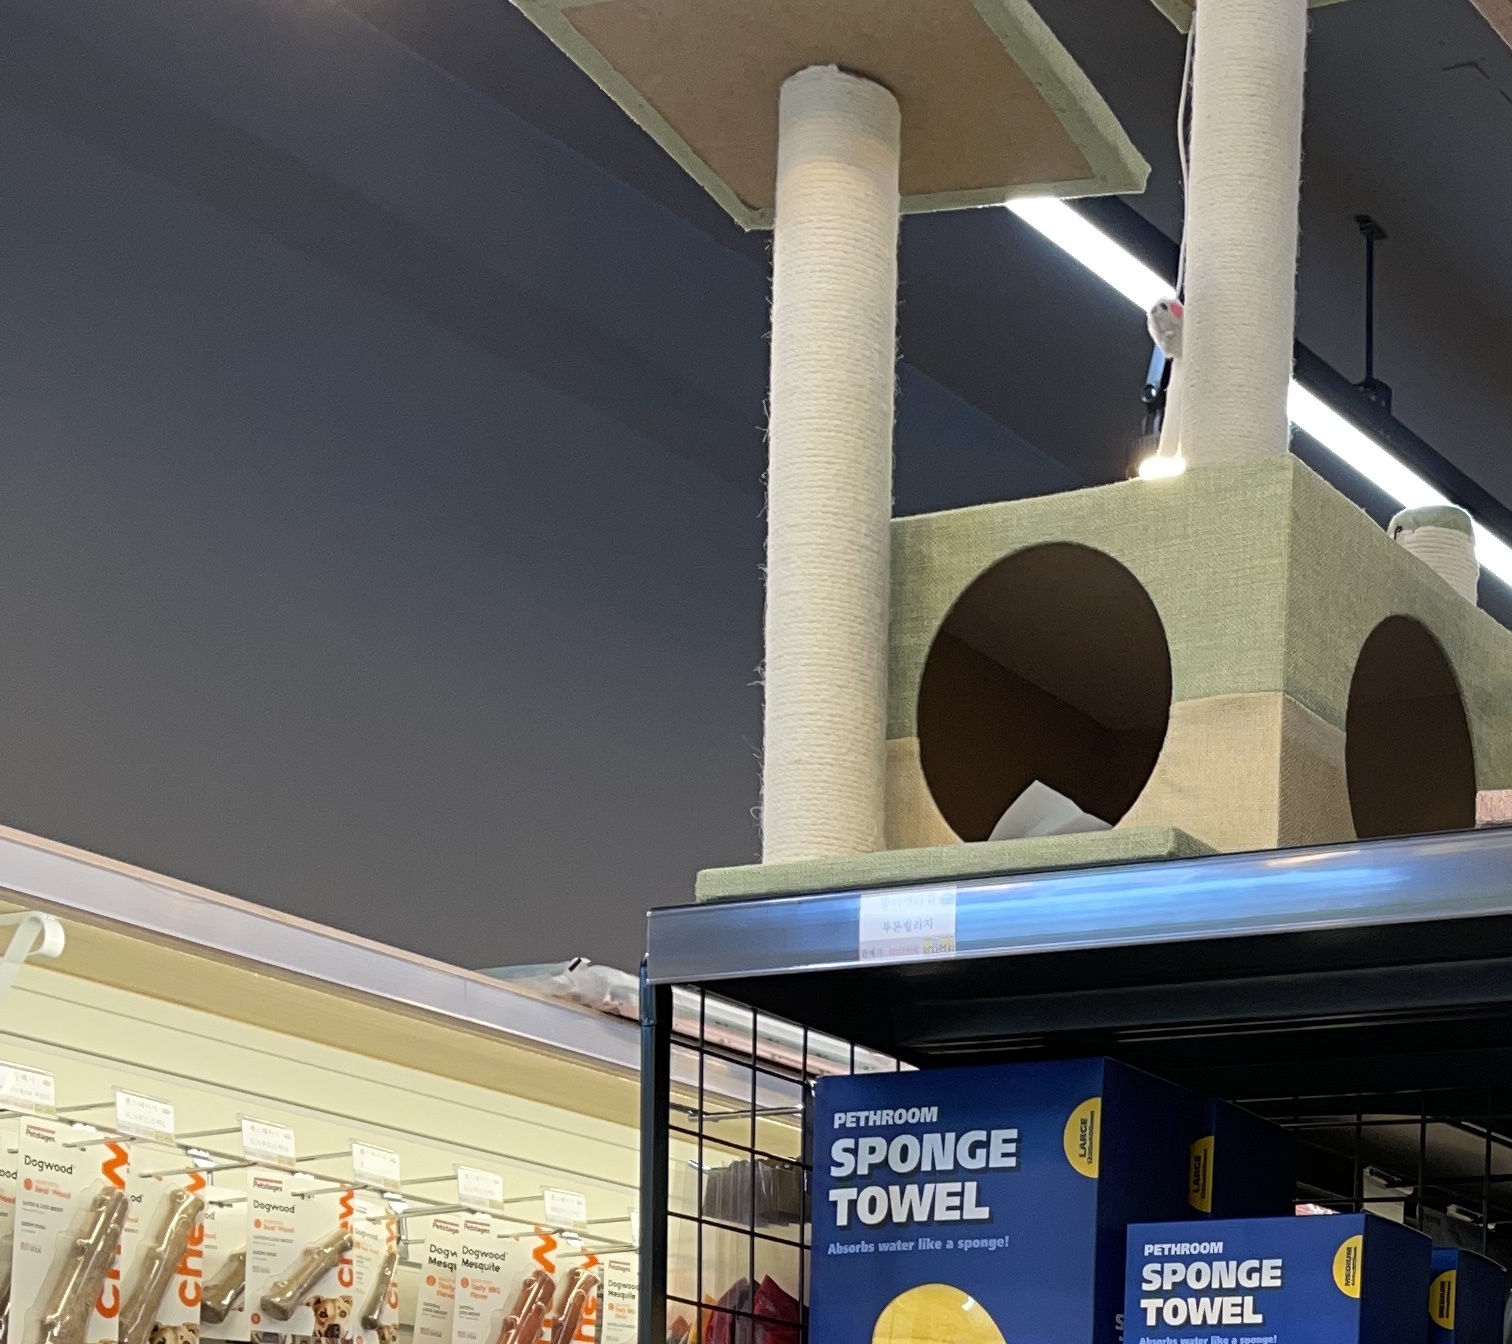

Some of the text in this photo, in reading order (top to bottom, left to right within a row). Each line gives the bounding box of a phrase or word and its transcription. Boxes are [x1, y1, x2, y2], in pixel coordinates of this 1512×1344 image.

[834, 1106, 938, 1129] PETHROOM
[1079, 1118, 1088, 1158] LARGE
[830, 1129, 1019, 1177] SPONGE
[24, 1155, 74, 1175] Dogwood
[253, 1200, 295, 1213] Dogwood
[829, 1181, 990, 1226] TOWEL
[462, 1245, 506, 1261] Dogwood
[828, 1236, 1009, 1255] Absorbs water like a sponge!
[1144, 1242, 1223, 1256] PETHROOM
[461, 1259, 500, 1273] Mesquite
[1141, 1259, 1283, 1291] SPONGE
[1140, 1296, 1263, 1326] TOWEL
[1211, 1335, 1229, 1344] like
